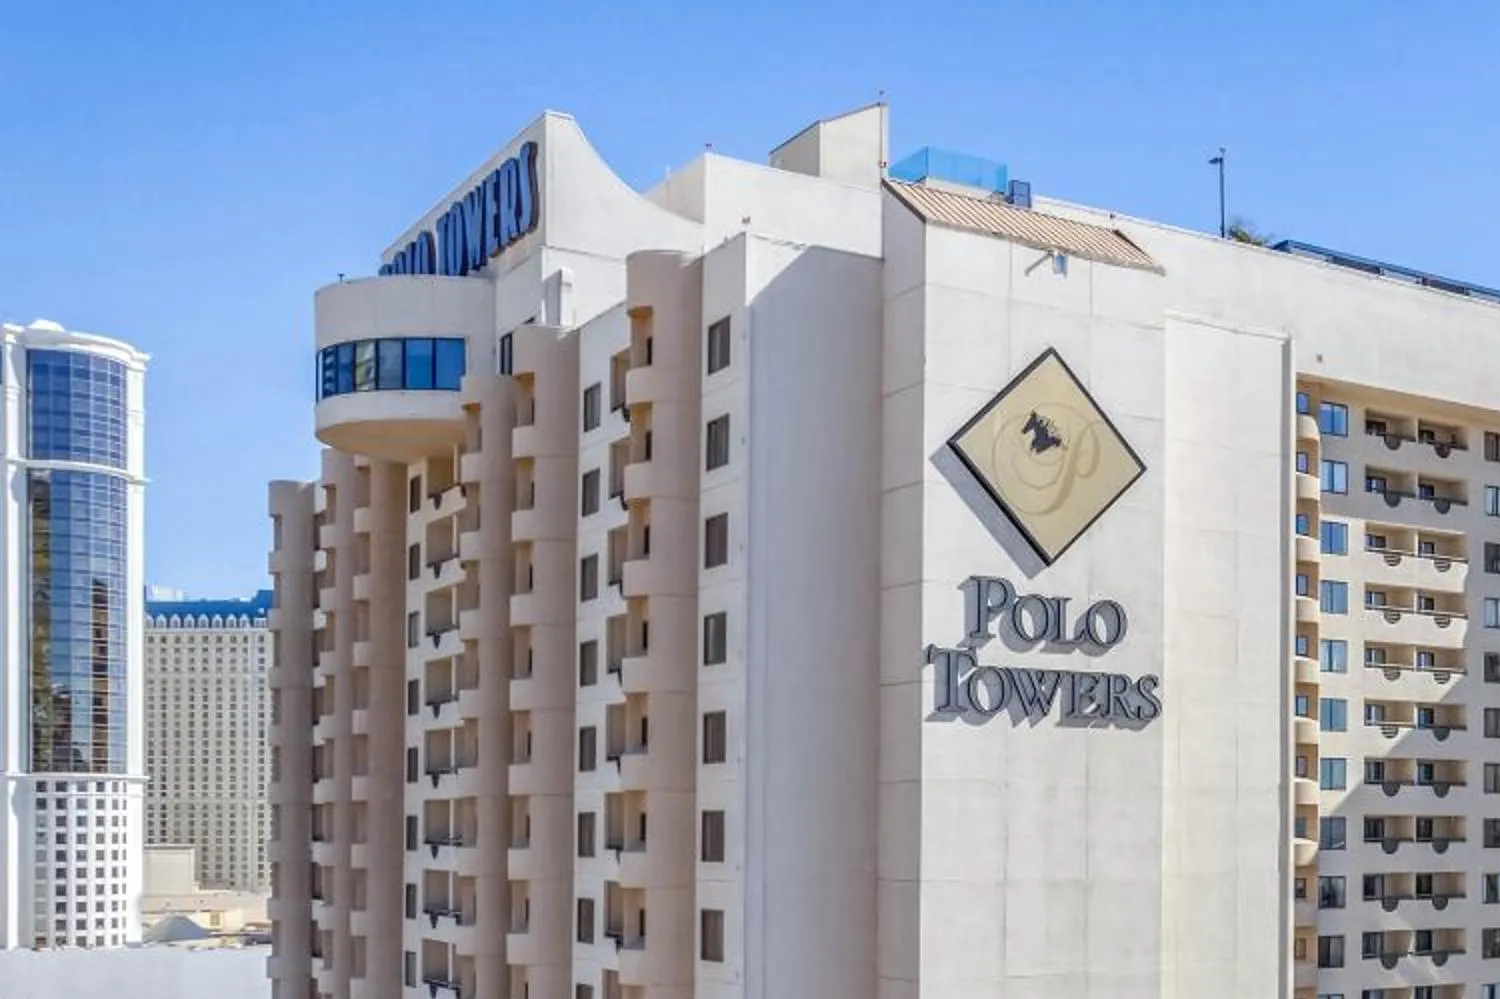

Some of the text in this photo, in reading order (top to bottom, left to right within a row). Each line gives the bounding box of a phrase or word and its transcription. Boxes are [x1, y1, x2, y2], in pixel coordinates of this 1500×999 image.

[436, 141, 539, 276] TOWERS
[958, 576, 1127, 650] POLO
[927, 643, 1162, 724] TOWERS
